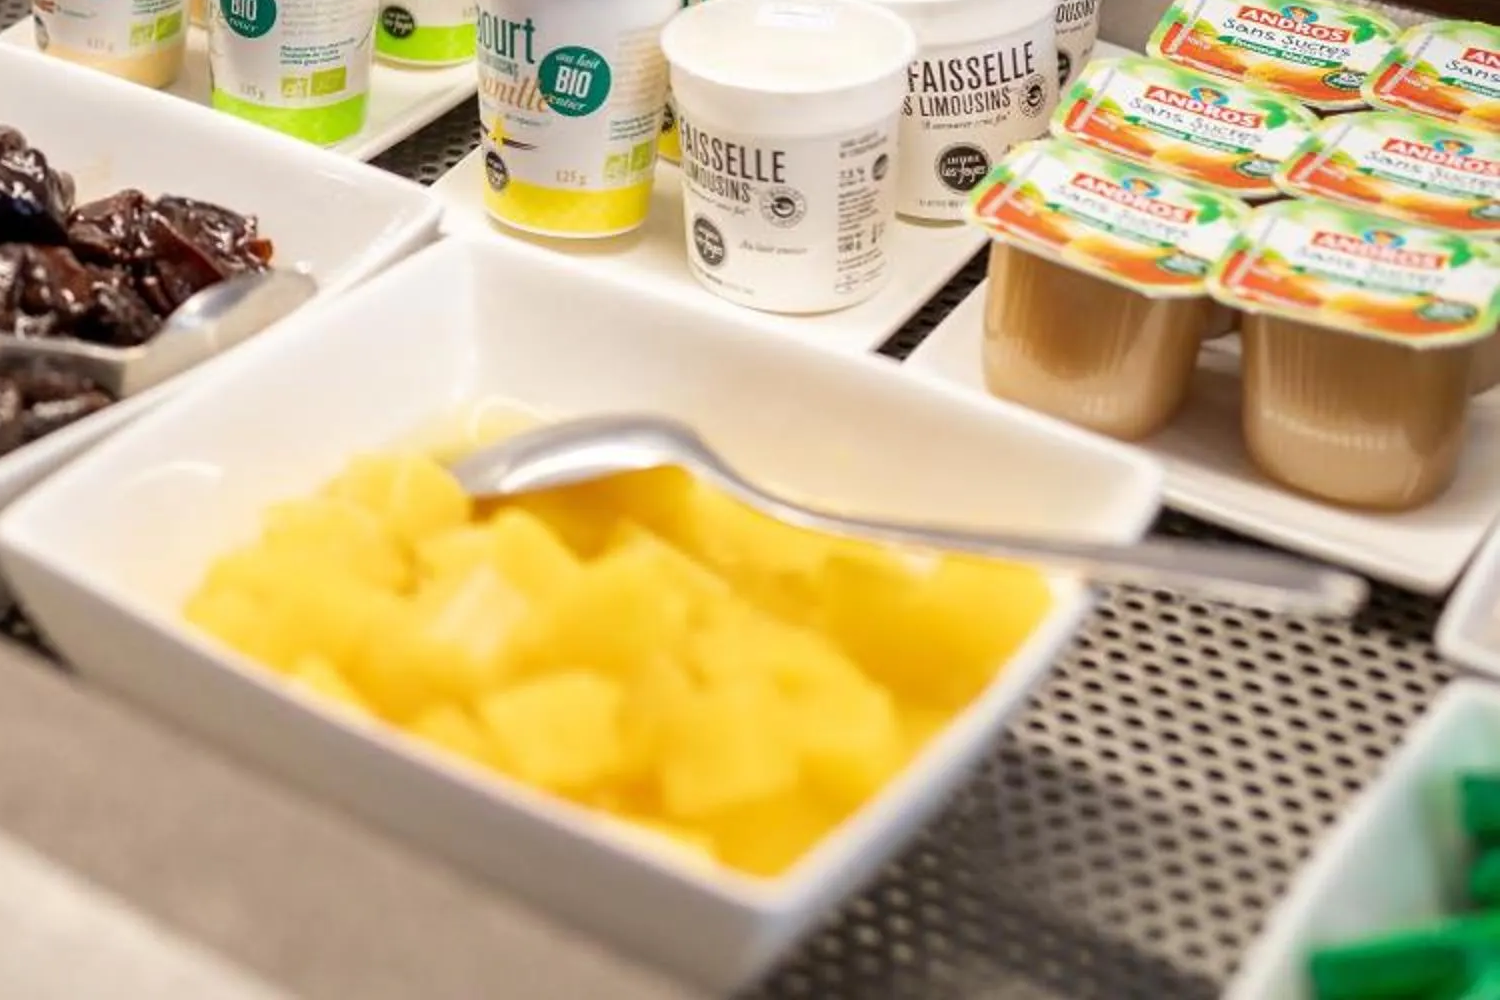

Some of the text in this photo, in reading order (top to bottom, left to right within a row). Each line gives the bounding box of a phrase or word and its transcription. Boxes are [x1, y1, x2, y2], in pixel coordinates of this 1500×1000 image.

[1241, 7, 1345, 43] ANDROS
[555, 66, 593, 99] BIO
[907, 40, 1035, 93] FAISSELLE
[918, 85, 1011, 118] LIMOUSINS
[1147, 87, 1256, 128] ANDROS
